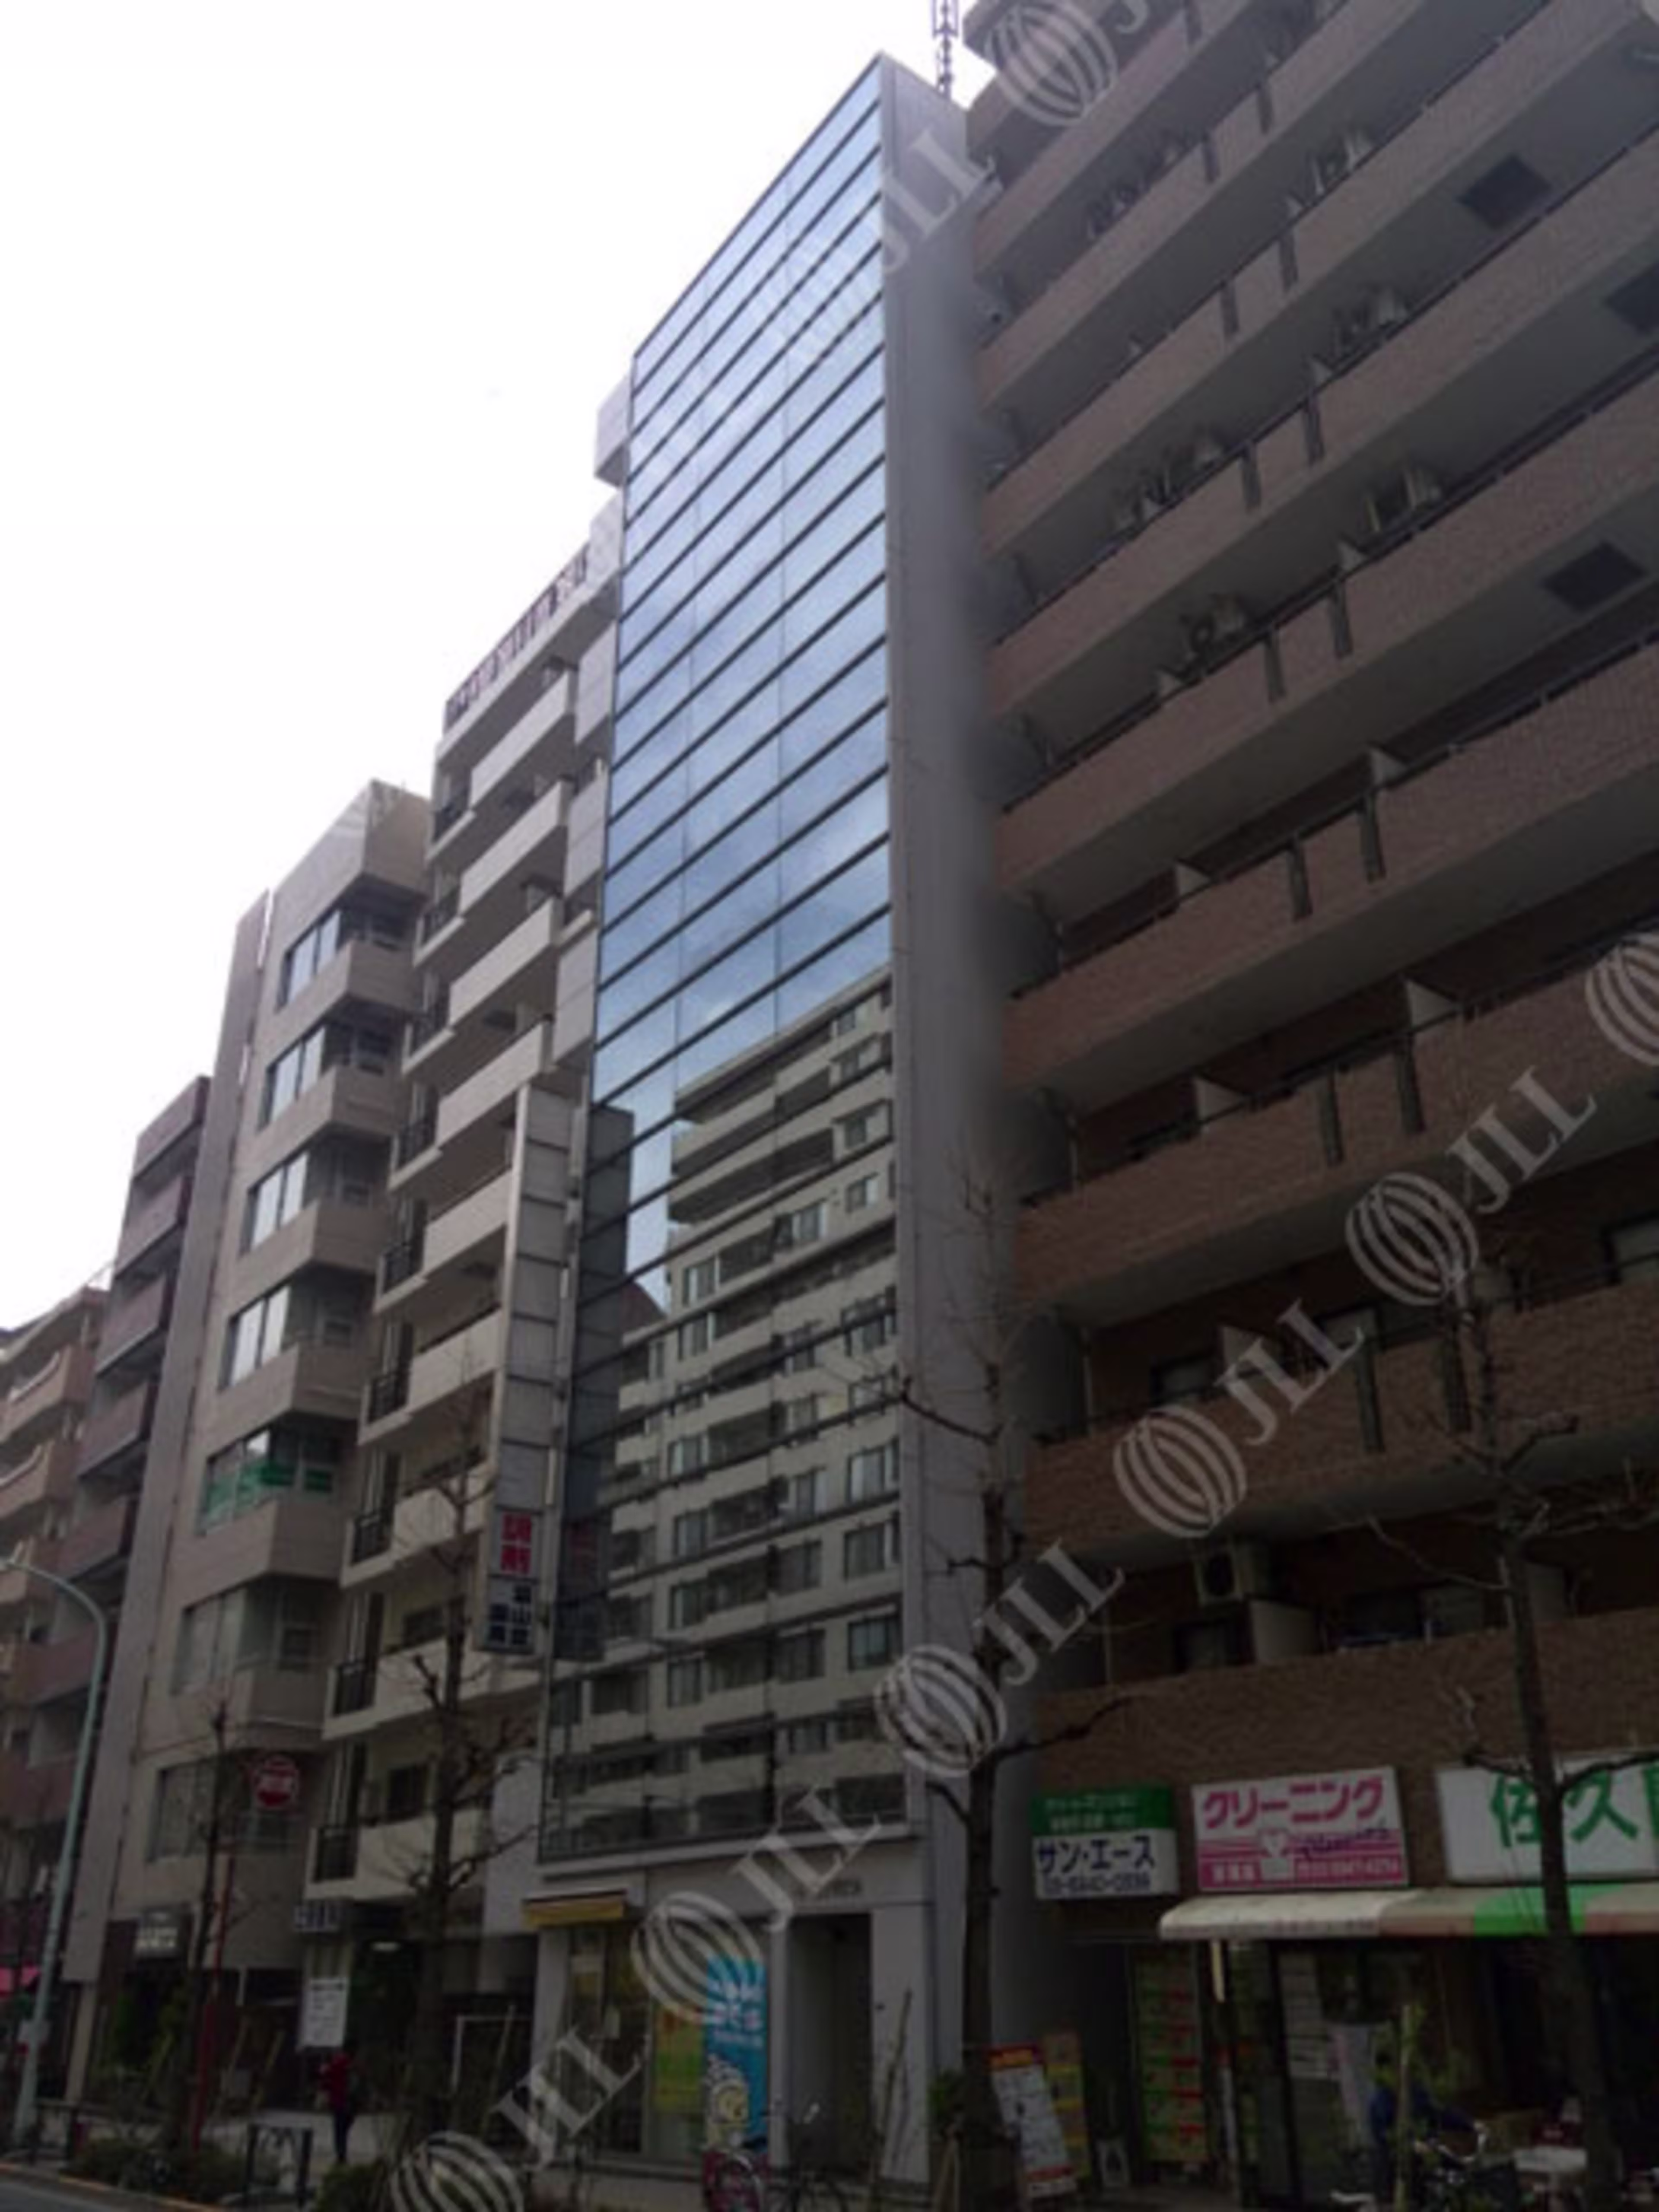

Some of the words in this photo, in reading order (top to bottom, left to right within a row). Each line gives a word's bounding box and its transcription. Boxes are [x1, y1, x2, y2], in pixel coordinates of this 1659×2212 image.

[1204, 1776, 1384, 1829] クリーニング
[1038, 1836, 1155, 1874] サン・エース
